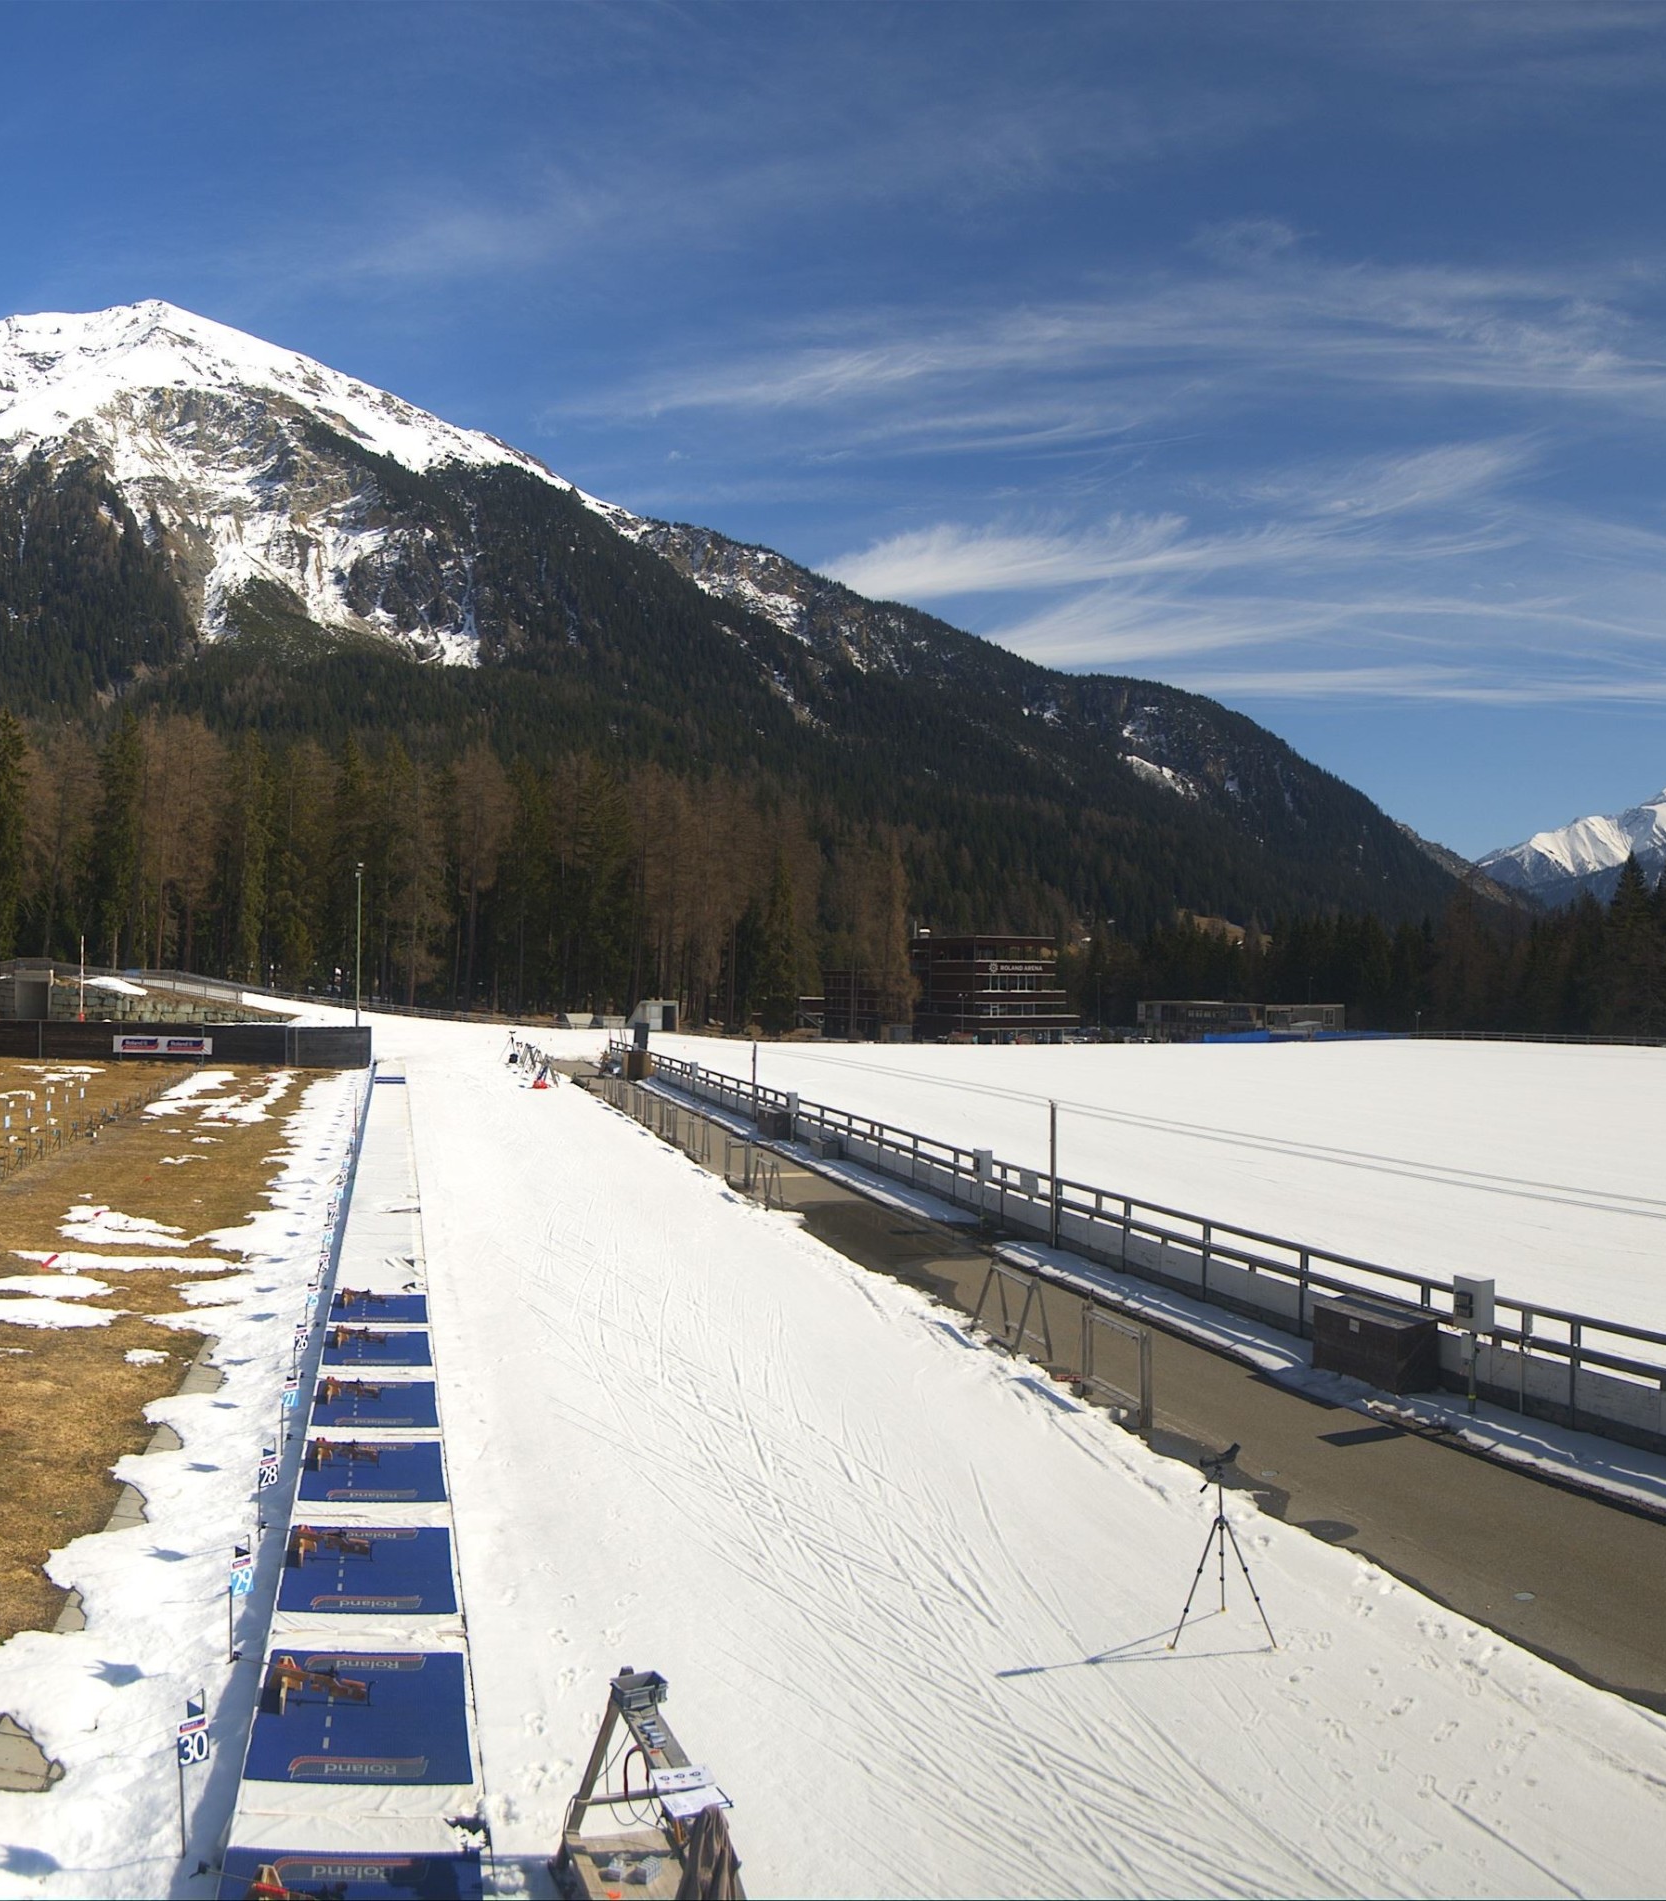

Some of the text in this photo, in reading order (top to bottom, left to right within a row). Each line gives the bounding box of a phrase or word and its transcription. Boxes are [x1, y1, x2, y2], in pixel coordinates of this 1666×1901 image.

[296, 1337, 308, 1351] 26
[284, 1391, 296, 1407] 27
[260, 1466, 277, 1487] 28
[233, 1569, 252, 1595] 29
[336, 1660, 398, 1669] Roland
[180, 1731, 208, 1765] 30
[324, 1763, 396, 1774] Roland
